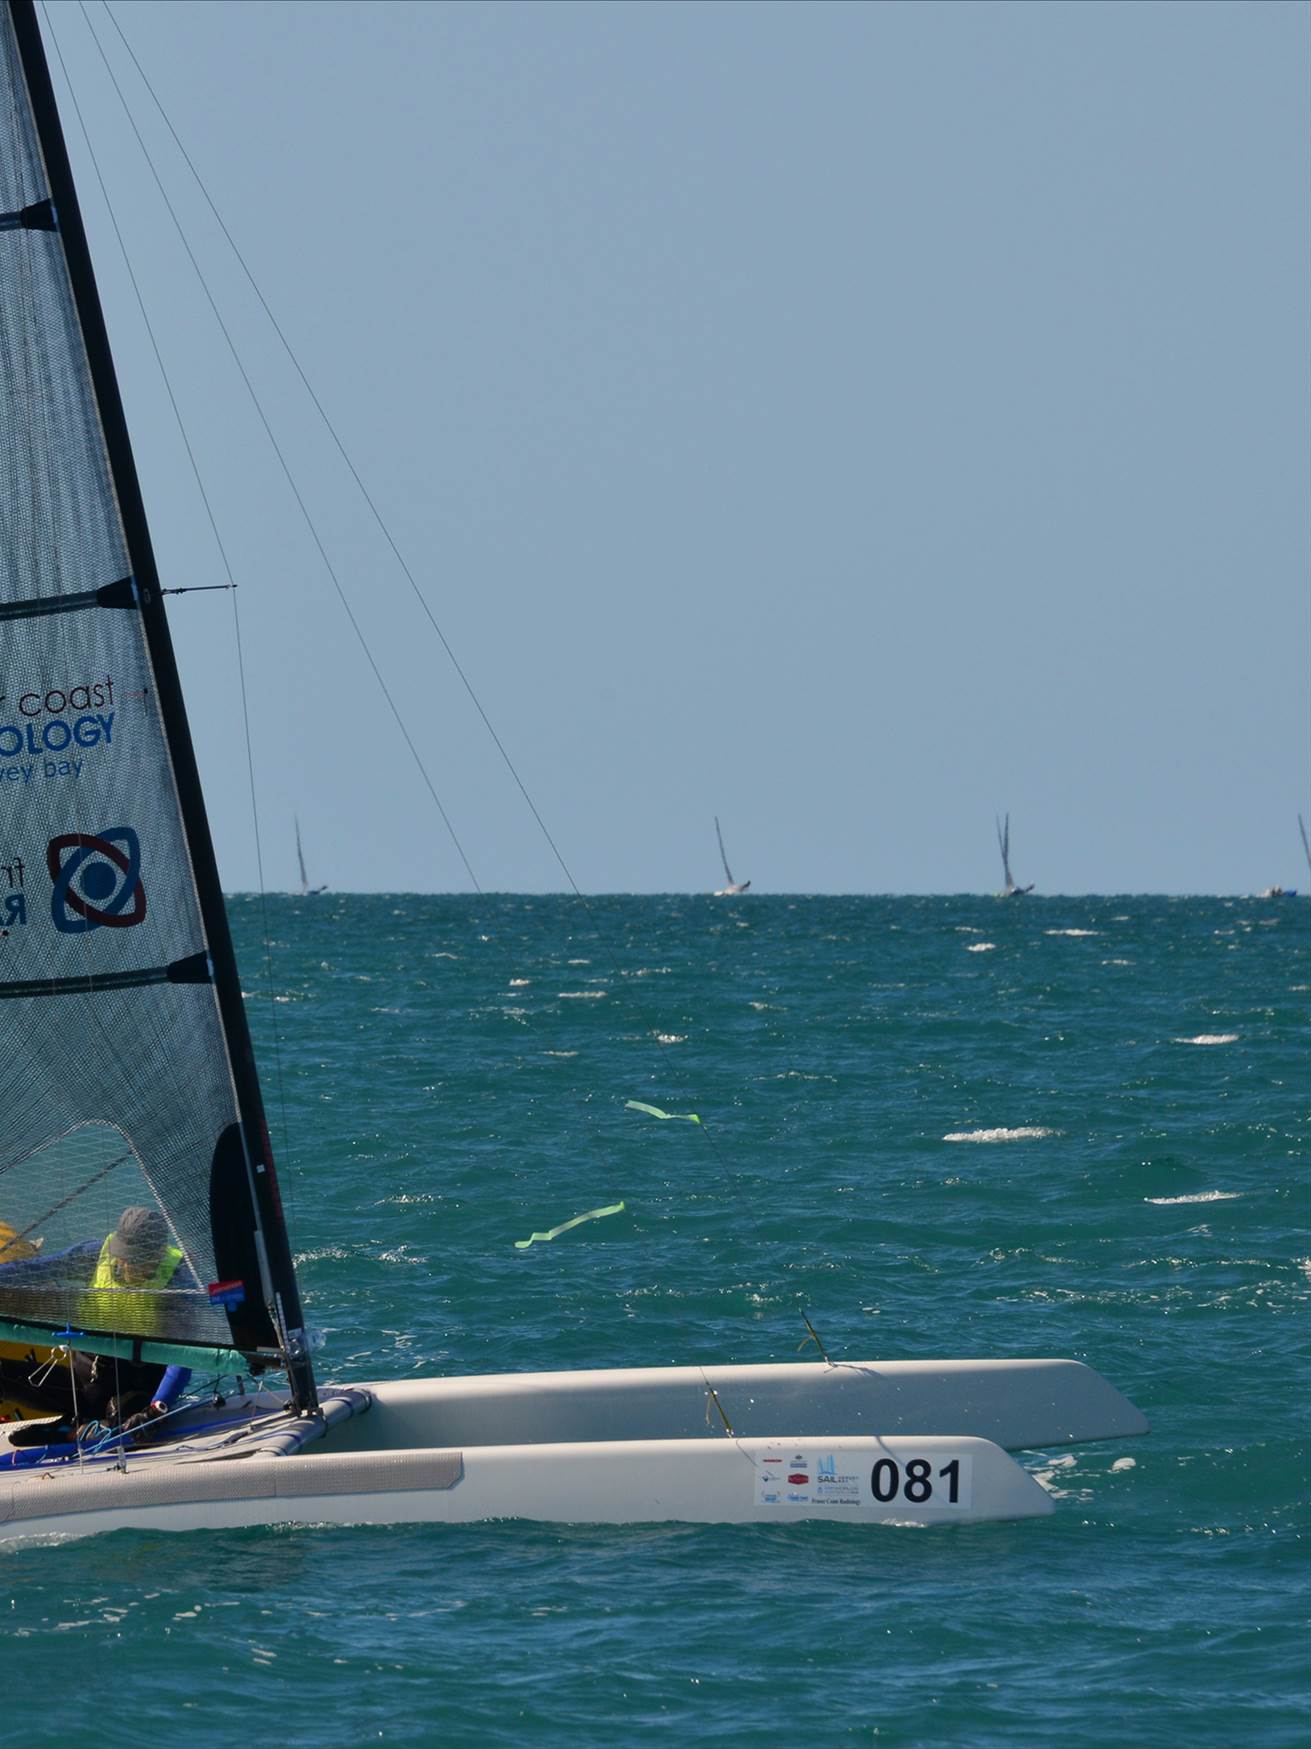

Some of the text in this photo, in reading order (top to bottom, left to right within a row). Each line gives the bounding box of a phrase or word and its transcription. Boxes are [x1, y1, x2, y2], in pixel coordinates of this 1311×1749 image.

[18, 674, 114, 717] coast
[43, 757, 84, 780] bay
[870, 1458, 960, 1504] 081
